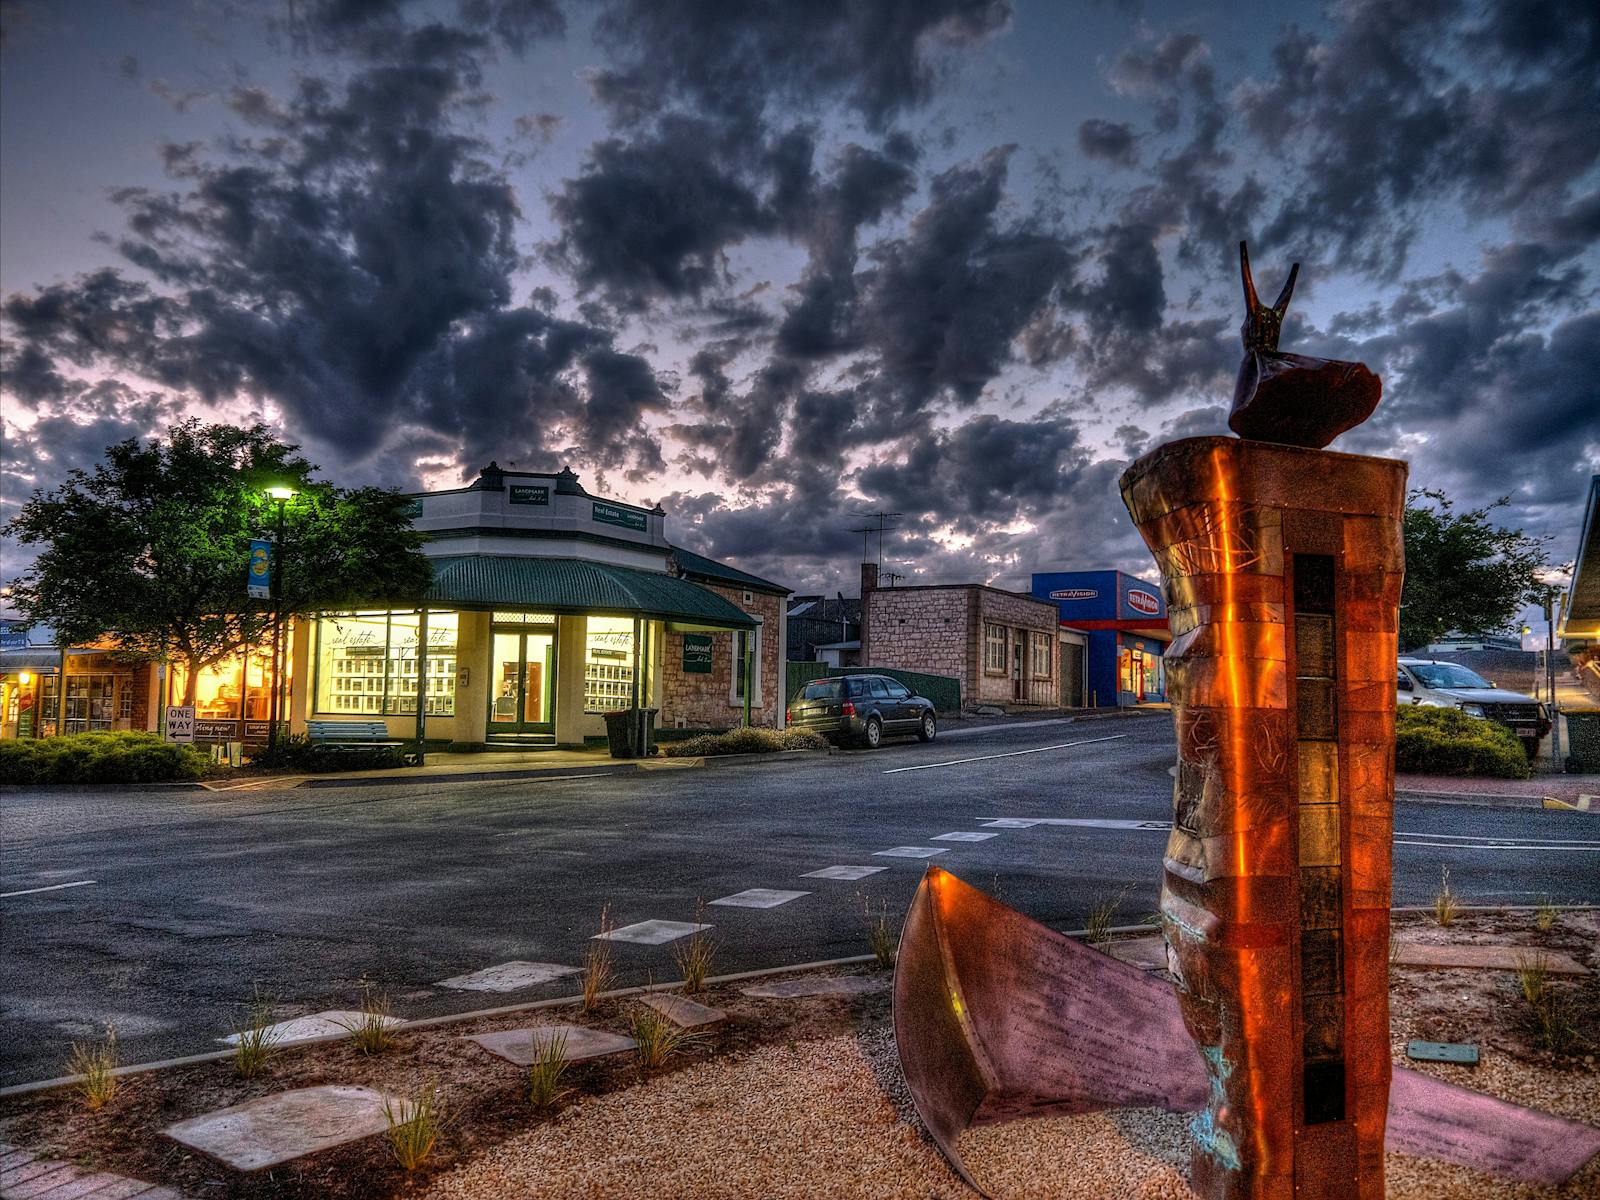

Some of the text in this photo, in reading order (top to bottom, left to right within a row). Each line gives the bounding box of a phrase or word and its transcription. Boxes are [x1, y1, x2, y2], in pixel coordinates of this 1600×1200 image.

[594, 506, 620, 518] Real Estate
[332, 629, 376, 645] real estate
[610, 631, 632, 646] estate
[170, 709, 191, 719] ONE
[168, 721, 192, 730] WAY
